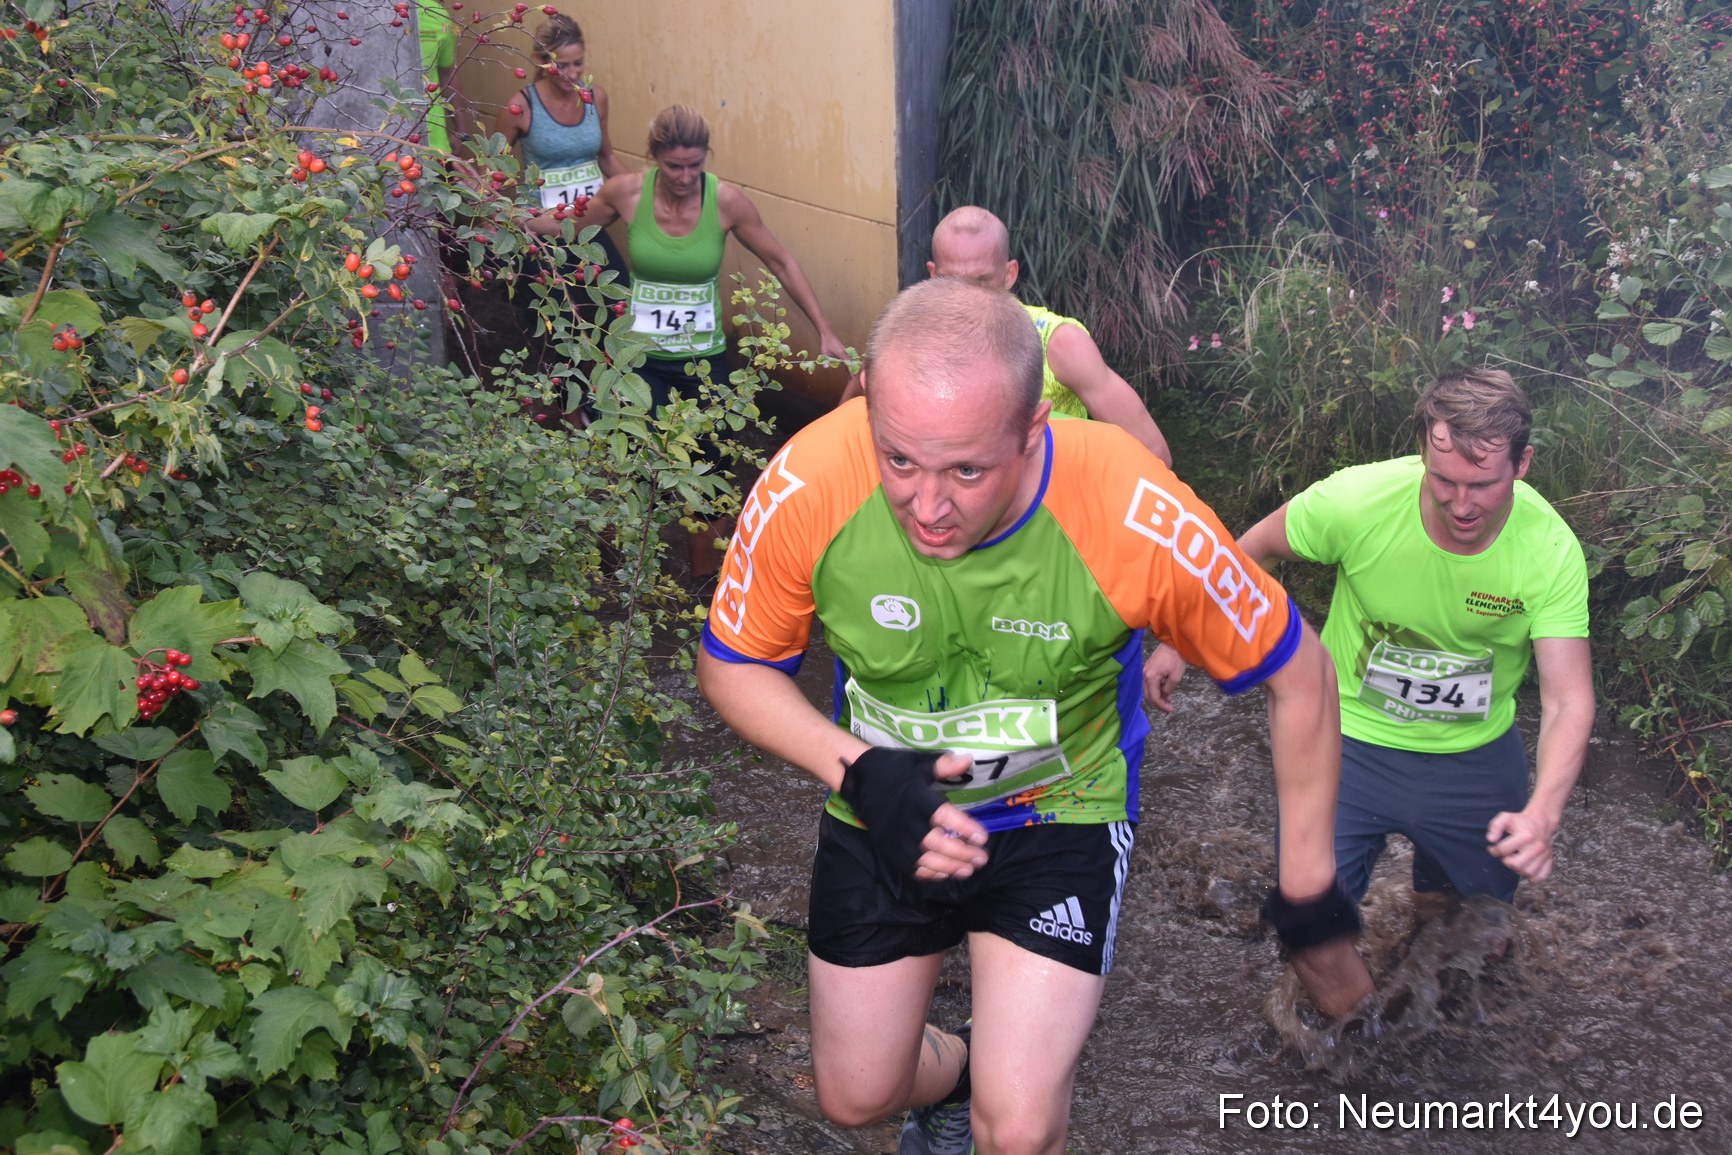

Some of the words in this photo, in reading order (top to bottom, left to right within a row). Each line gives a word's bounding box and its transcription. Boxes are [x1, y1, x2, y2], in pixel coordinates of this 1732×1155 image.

[545, 164, 600, 187] BOCK
[639, 284, 708, 304] BOCK
[1124, 477, 1271, 643] BOCK
[992, 616, 1071, 641] BOCK
[1396, 677, 1465, 708] 134
[857, 694, 1038, 747] BOCK
[1029, 917, 1094, 946] adidas
